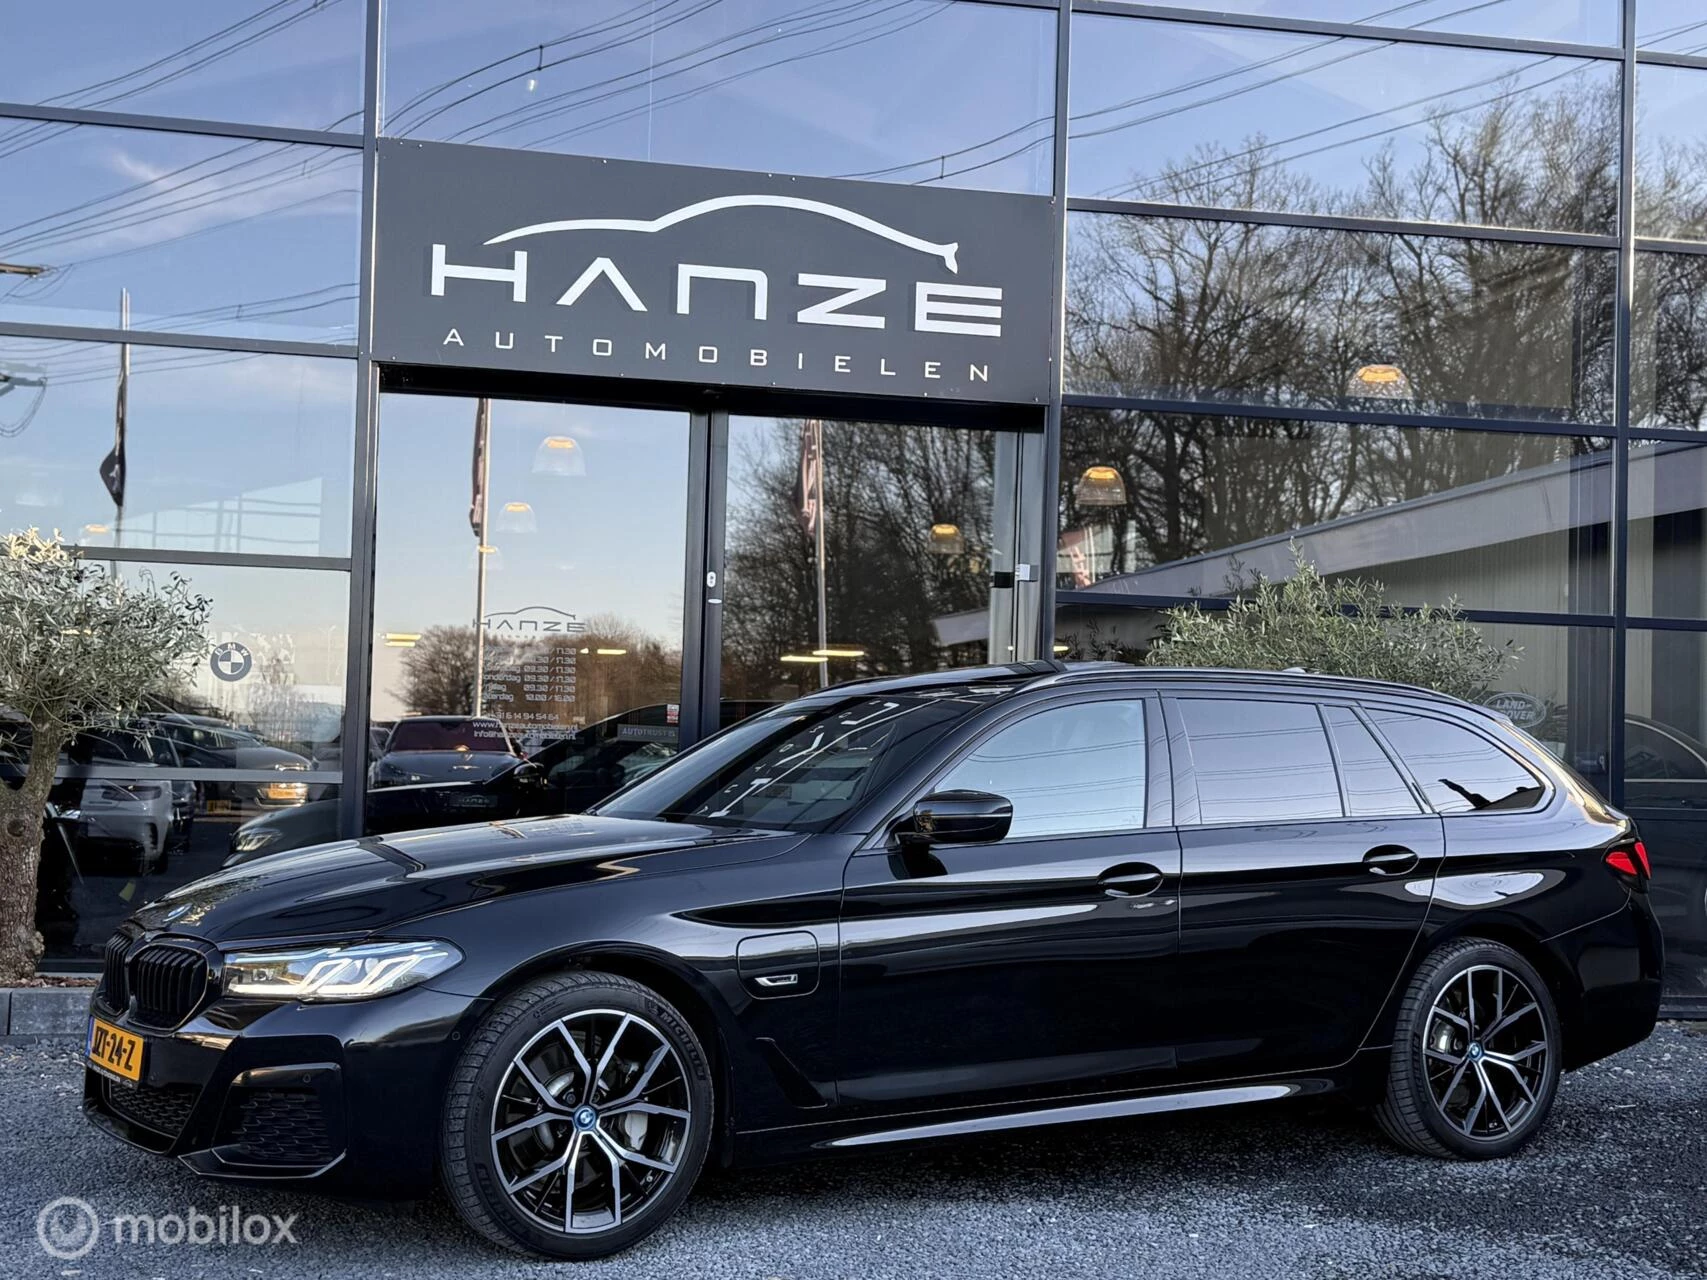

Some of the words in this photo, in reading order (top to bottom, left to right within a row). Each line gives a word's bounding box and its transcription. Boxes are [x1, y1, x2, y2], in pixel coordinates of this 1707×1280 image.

[430, 242, 1003, 338] HANZE
[443, 327, 989, 382] AUTOMOBIELEN
[214, 643, 250, 657] BMW
